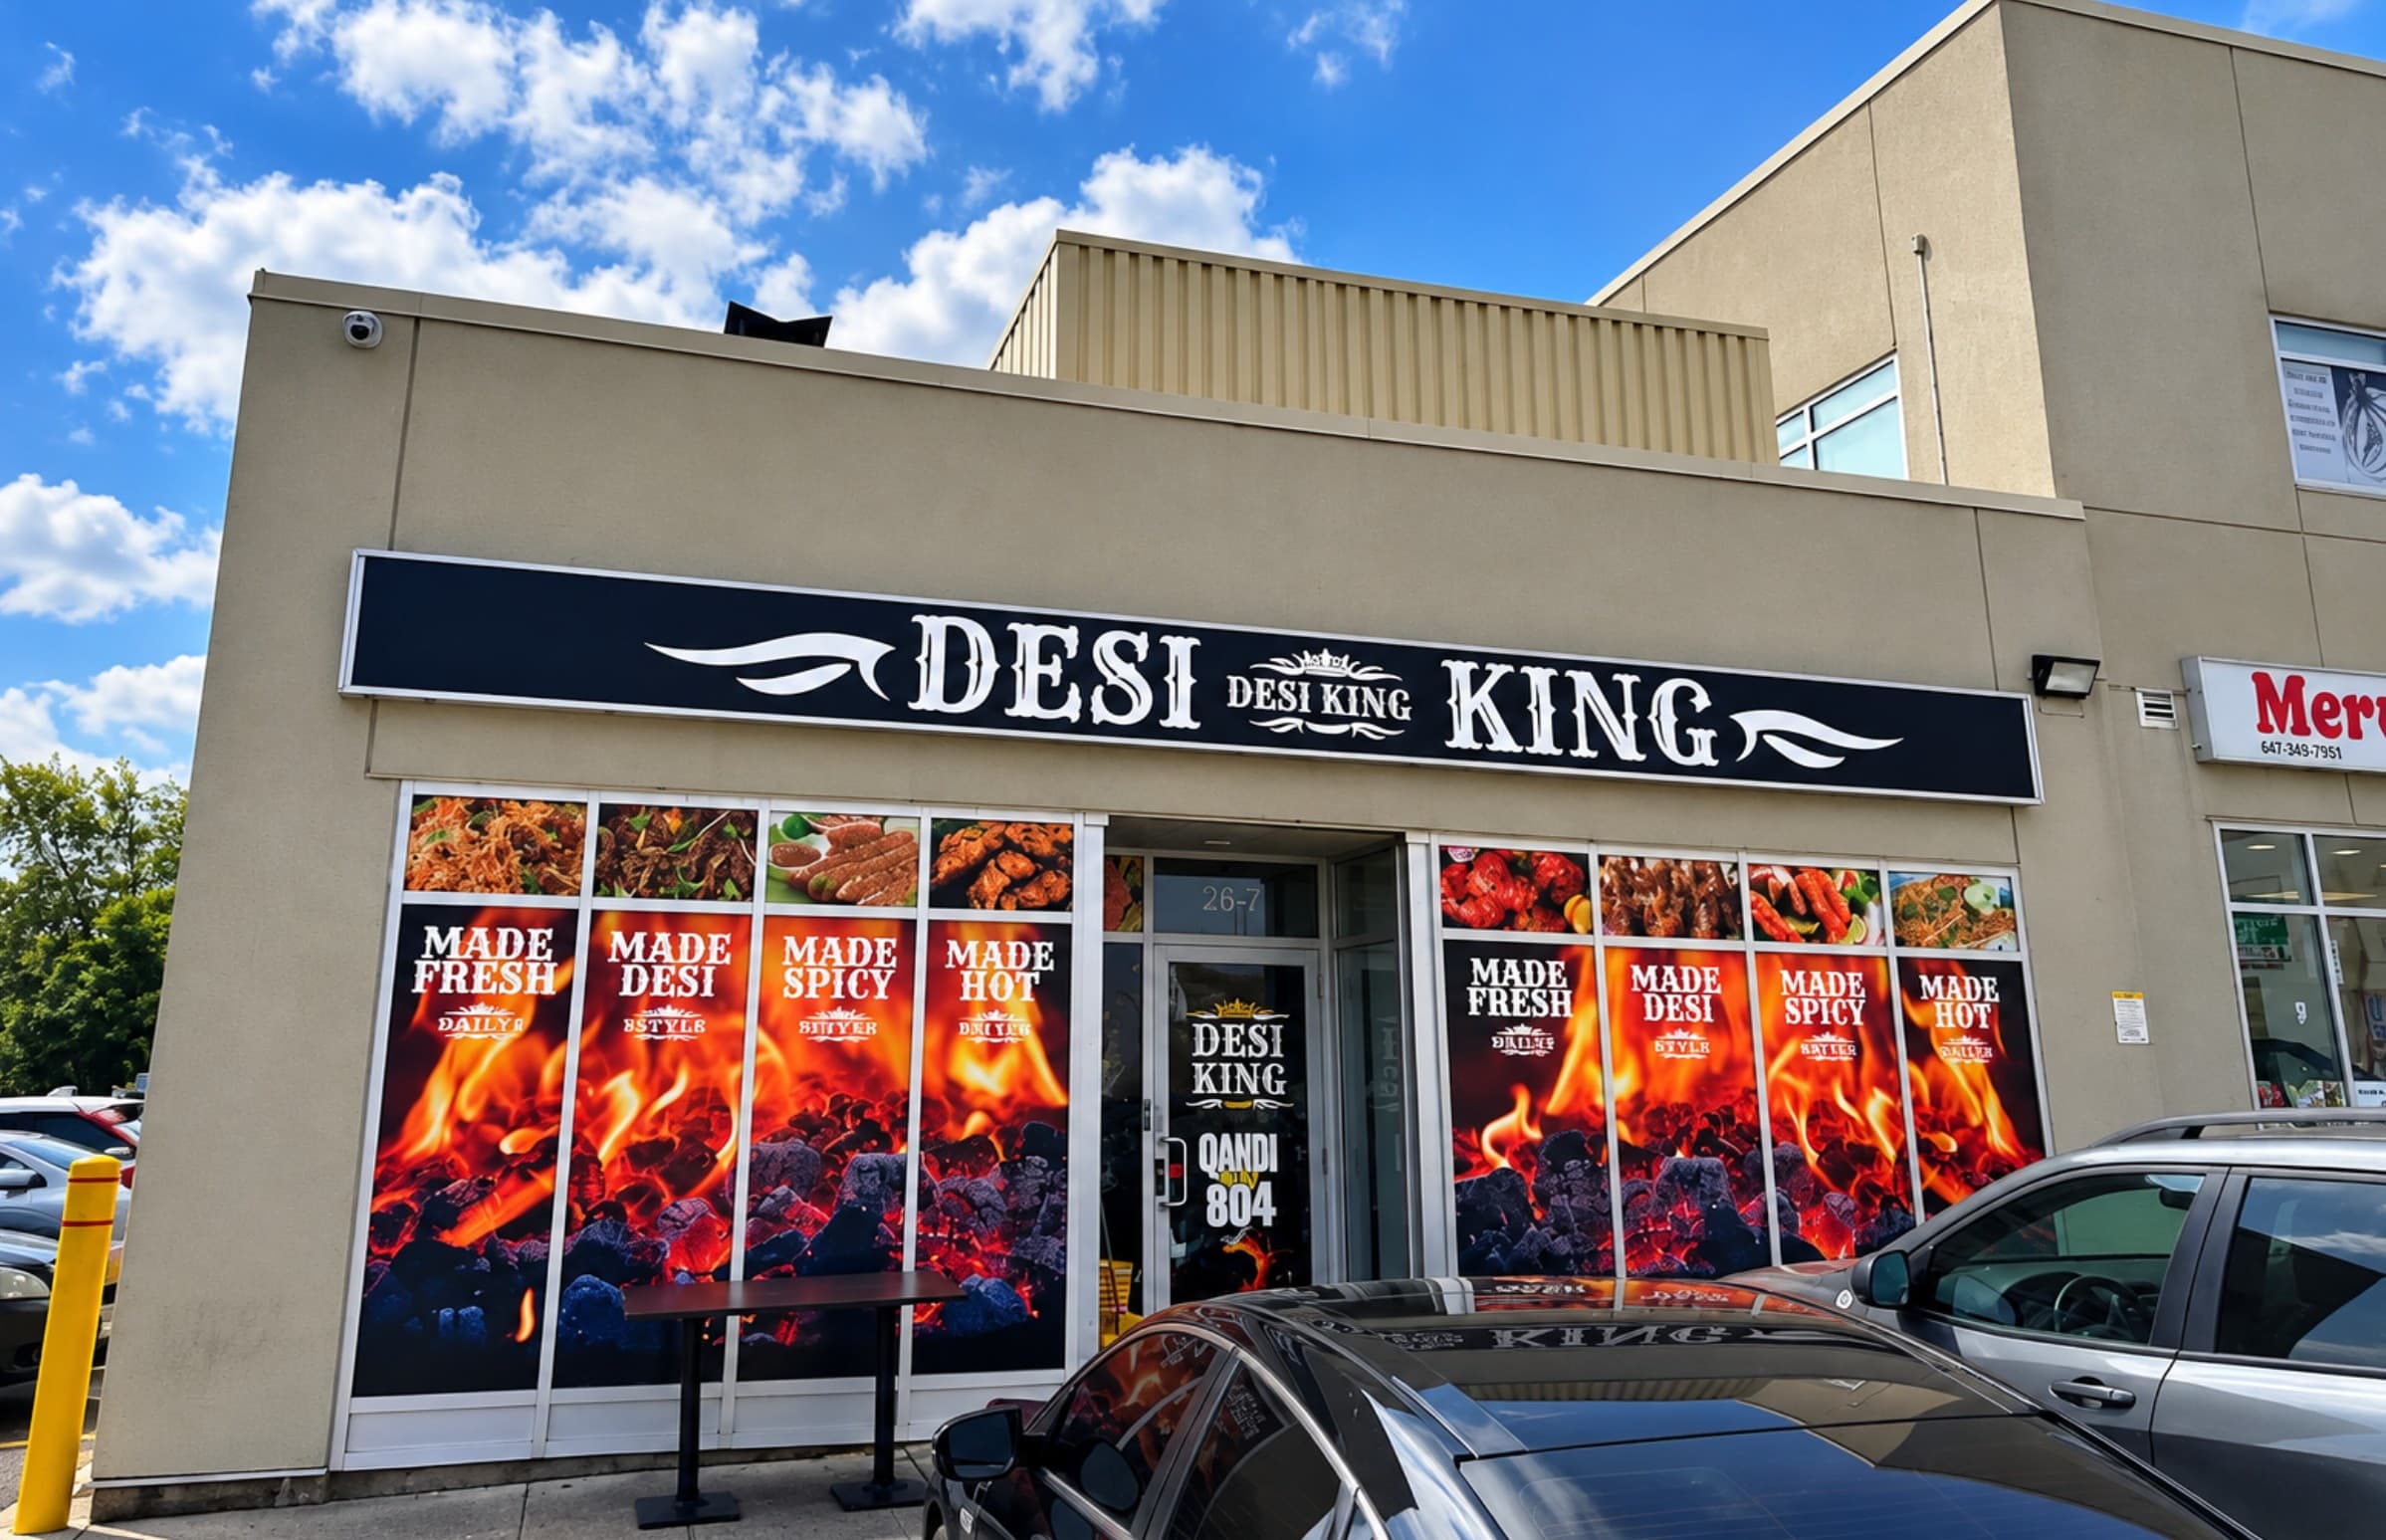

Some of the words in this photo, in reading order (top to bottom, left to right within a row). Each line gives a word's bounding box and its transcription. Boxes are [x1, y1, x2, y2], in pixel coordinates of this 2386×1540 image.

[908, 614, 1201, 730] DESI
[1441, 660, 1720, 768] KING
[1226, 675, 1311, 713] DESI
[1320, 683, 1412, 721] KING
[1202, 885, 1260, 912] 26-7
[421, 926, 553, 961] MADE
[607, 931, 732, 965] MADE
[782, 936, 897, 968] MADE
[945, 940, 1054, 972] MADE
[411, 960, 557, 994] FRESH
[618, 964, 715, 997] DESI
[782, 968, 895, 999] SPICY
[960, 970, 1040, 1001] HOT
[1469, 958, 1568, 989] MADE
[1629, 965, 1722, 993] MADE
[1779, 970, 1866, 998] MADE
[1918, 975, 2000, 1002] MADE
[1466, 987, 1573, 1017] FRESH
[1642, 992, 1715, 1022] DESI
[1784, 997, 1866, 1025] SPICY
[1934, 1001, 1992, 1028] HOT
[1192, 1022, 1284, 1058] DESI
[1192, 1062, 1287, 1095] KING
[1198, 1132, 1278, 1180] QANDI
[1205, 1181, 1277, 1227] 804
